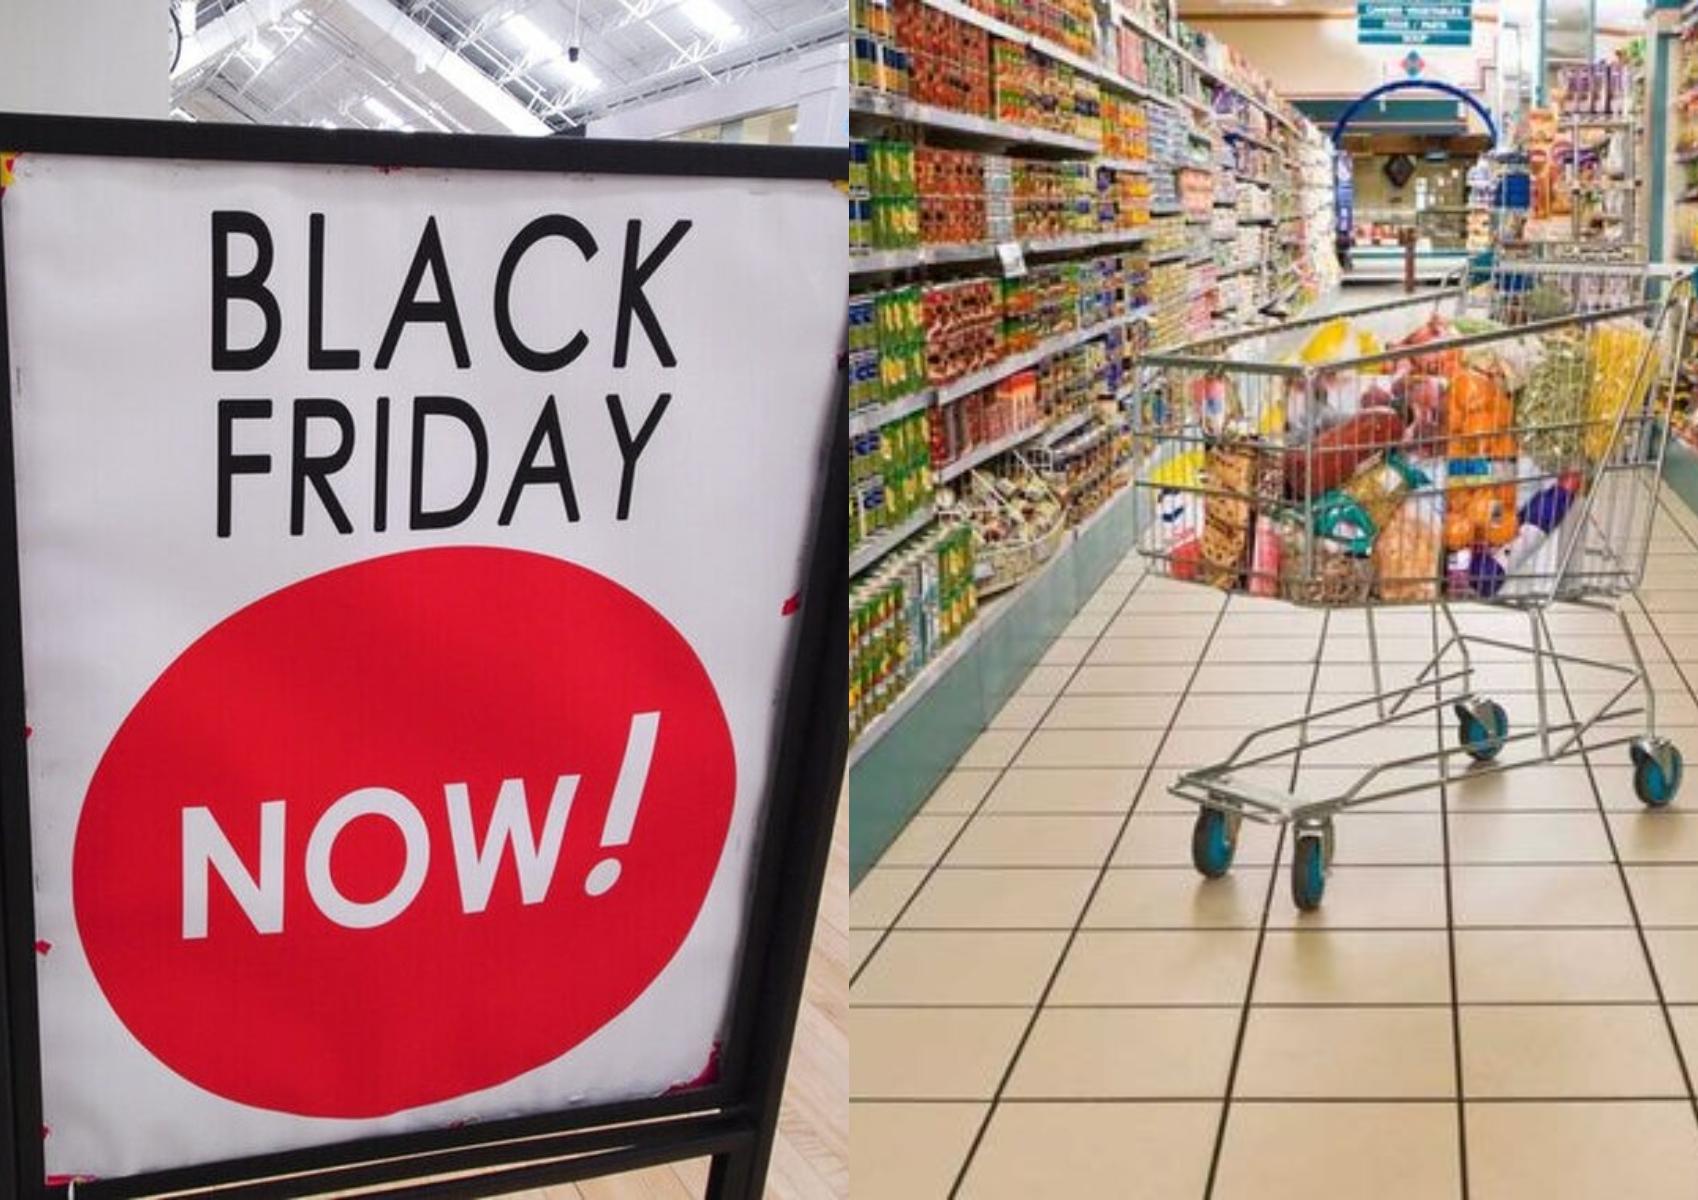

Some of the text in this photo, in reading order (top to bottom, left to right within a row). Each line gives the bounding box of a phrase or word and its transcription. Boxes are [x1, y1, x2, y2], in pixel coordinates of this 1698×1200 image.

[212, 210, 693, 372] BLACK
[217, 393, 672, 538] FRIDAY
[182, 711, 661, 939] NOW!
